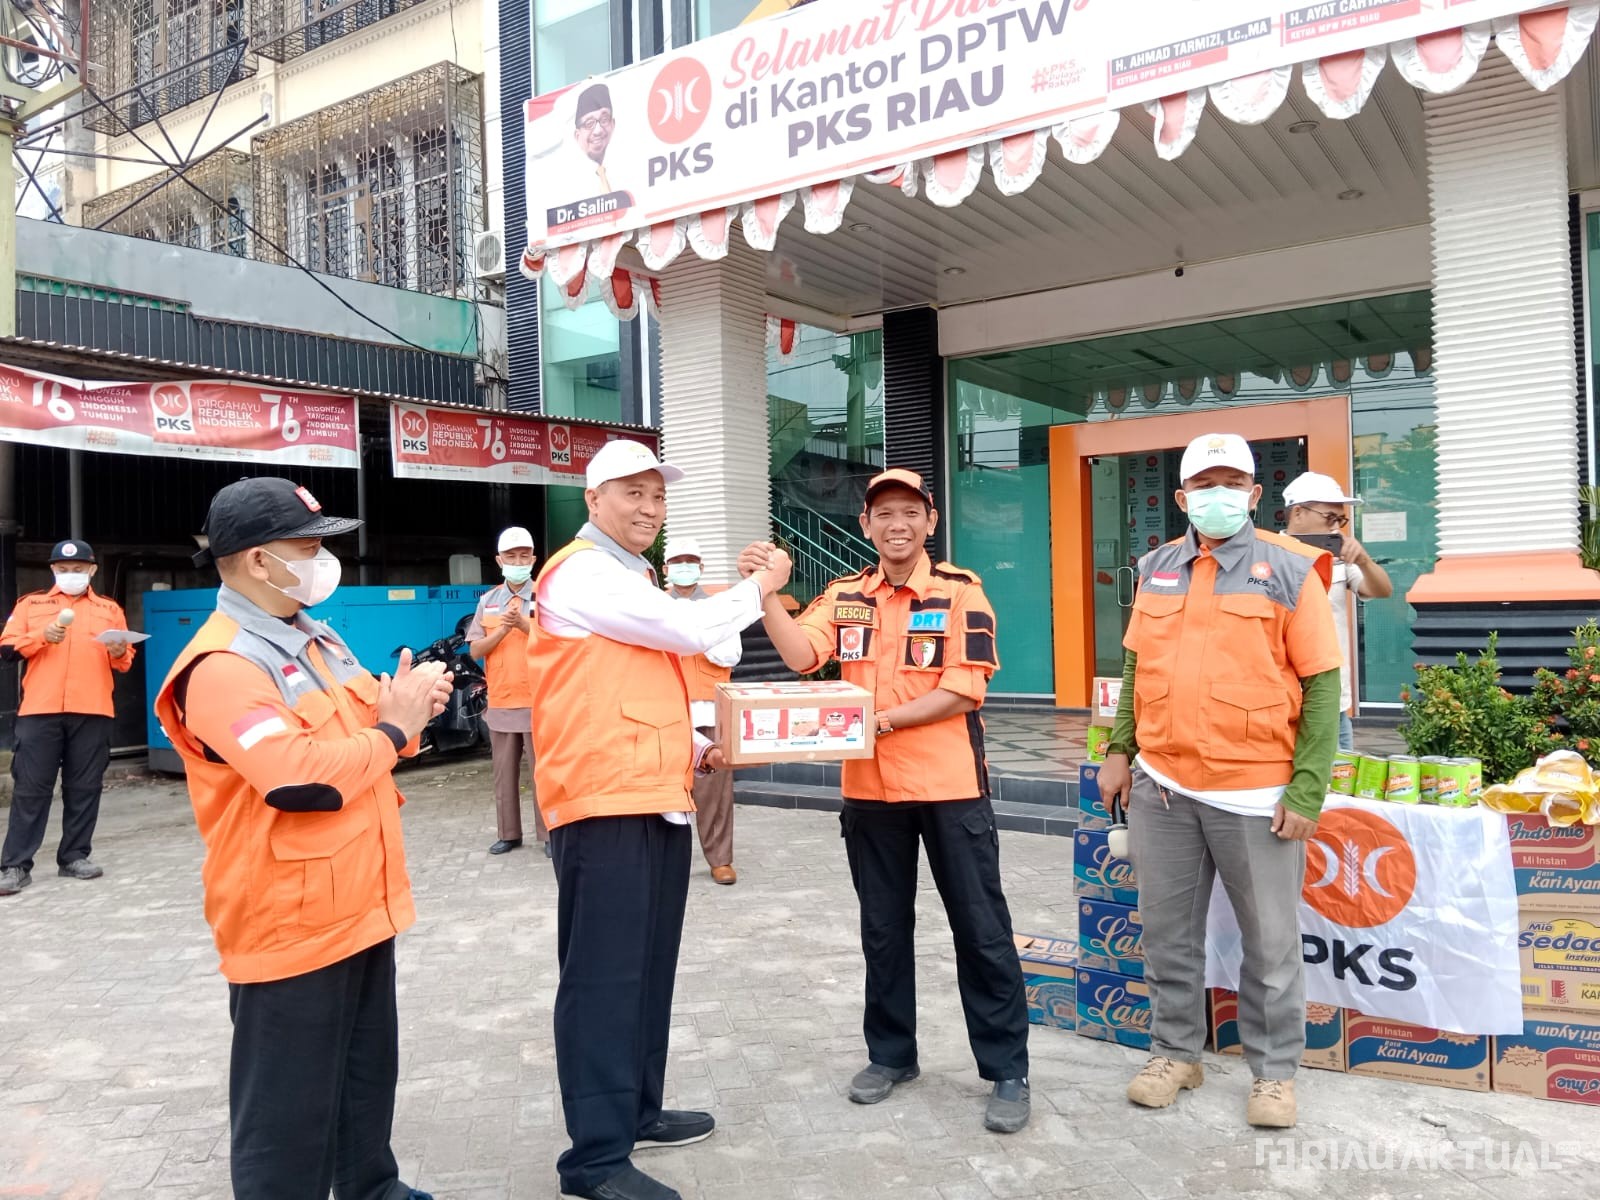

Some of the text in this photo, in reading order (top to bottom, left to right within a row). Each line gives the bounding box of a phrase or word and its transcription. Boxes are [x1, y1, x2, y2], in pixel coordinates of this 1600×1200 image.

[1290, 12, 1302, 26] H.
[1306, 3, 1337, 21] AYAT
[1290, 27, 1316, 40] KETUA
[1341, 18, 1357, 28] PKS
[723, 1, 905, 89] Selamat
[1115, 59, 1127, 73] H.
[1130, 47, 1171, 68] AHMAD
[1173, 33, 1225, 58] TARMIZI,
[725, 86, 757, 130] di
[771, 52, 906, 118] Kantor
[920, 0, 1070, 75] DPTW
[787, 64, 1005, 159] PKS RIAU
[648, 142, 714, 187] PKS
[556, 208, 576, 224] Dr.
[578, 197, 618, 218] Salim
[79, 394, 125, 405] TANGGUH
[197, 398, 262, 413] DIRGAHAYU
[288, 396, 299, 404] TH
[80, 401, 138, 414] INDONESIA
[198, 408, 253, 420] REPUBLIK
[82, 410, 124, 422] TUMBUH
[307, 412, 340, 422] TANGGUH
[157, 417, 192, 431] PKS
[198, 417, 263, 429] INDONESIA
[306, 420, 350, 431] INDONESIA
[306, 429, 338, 438] TUMBUH
[432, 431, 474, 441] REPUBLIK
[477, 418, 506, 461] 76
[403, 439, 427, 451] PKS
[432, 438, 479, 450] INDONESIA
[551, 451, 570, 462] PKS
[1247, 577, 1269, 587] PKS
[836, 607, 872, 620] RESCUE
[912, 613, 945, 627] DRT
[841, 652, 860, 660] PKS
[1523, 855, 1567, 865] Mi Instan
[1529, 875, 1562, 889] Kari
[1528, 923, 1553, 931] Mie
[1301, 934, 1417, 992] PKS
[1372, 1025, 1413, 1039] Mi Instan
[1535, 1025, 1578, 1040] Ayam
[1376, 1045, 1449, 1066] Kari Ayam
